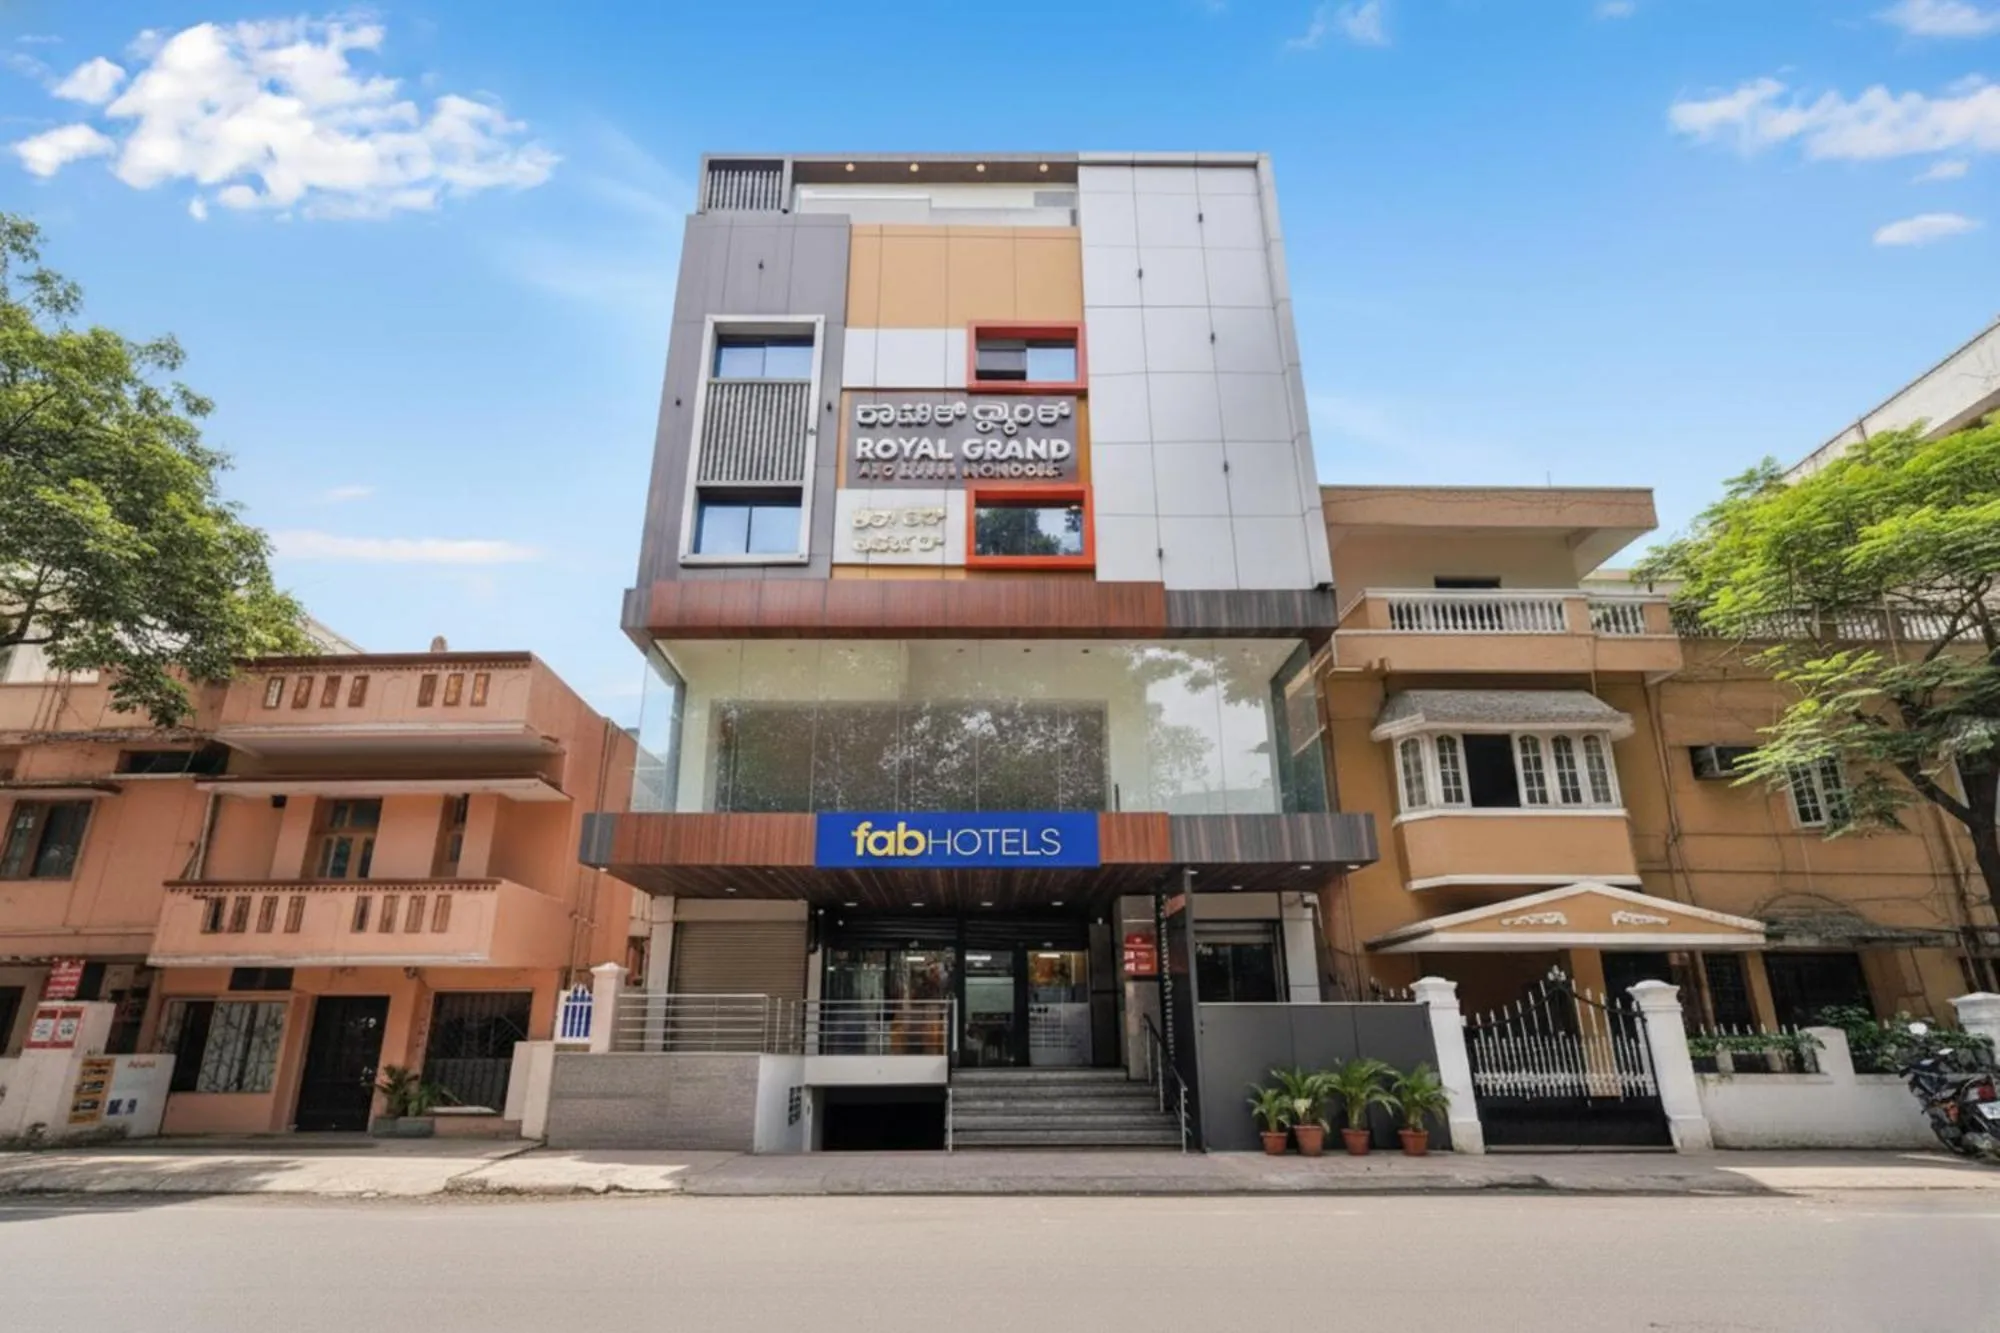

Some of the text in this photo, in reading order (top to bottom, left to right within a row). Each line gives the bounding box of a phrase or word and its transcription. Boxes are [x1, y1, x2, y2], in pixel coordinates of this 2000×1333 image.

[856, 437, 1070, 460] ROYAL GRAND
[851, 821, 1062, 856] fabHOTELS
